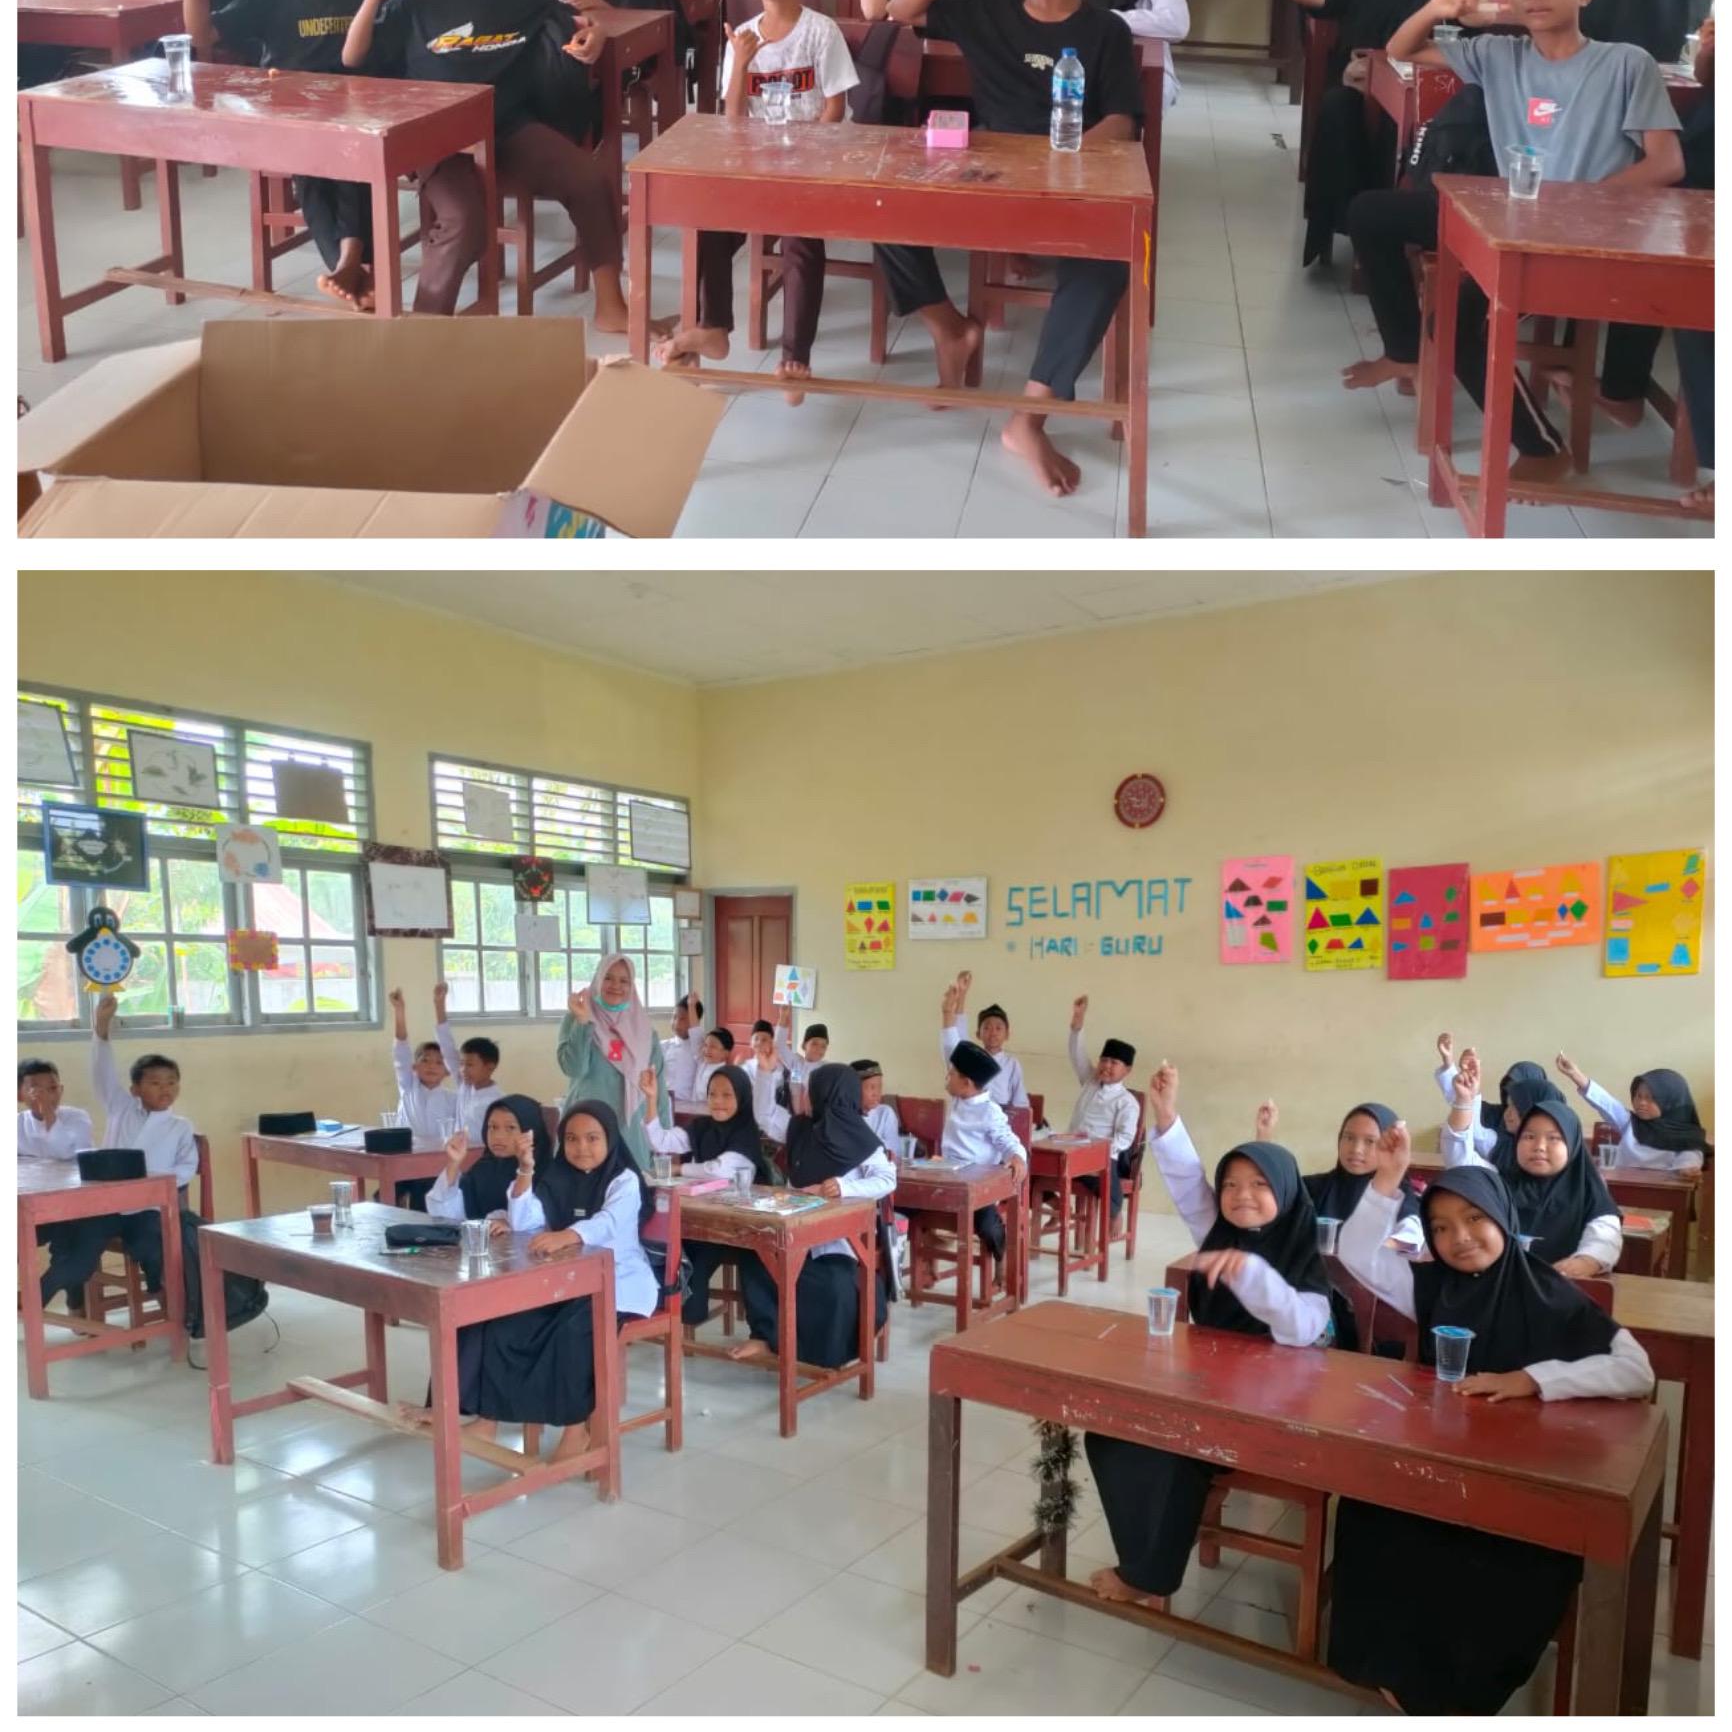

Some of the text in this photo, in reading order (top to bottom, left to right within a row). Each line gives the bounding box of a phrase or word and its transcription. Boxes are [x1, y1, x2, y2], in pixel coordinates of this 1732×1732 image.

[1006, 877, 1193, 927] SELAMAT
[1029, 934, 1163, 960] HARI GURU
